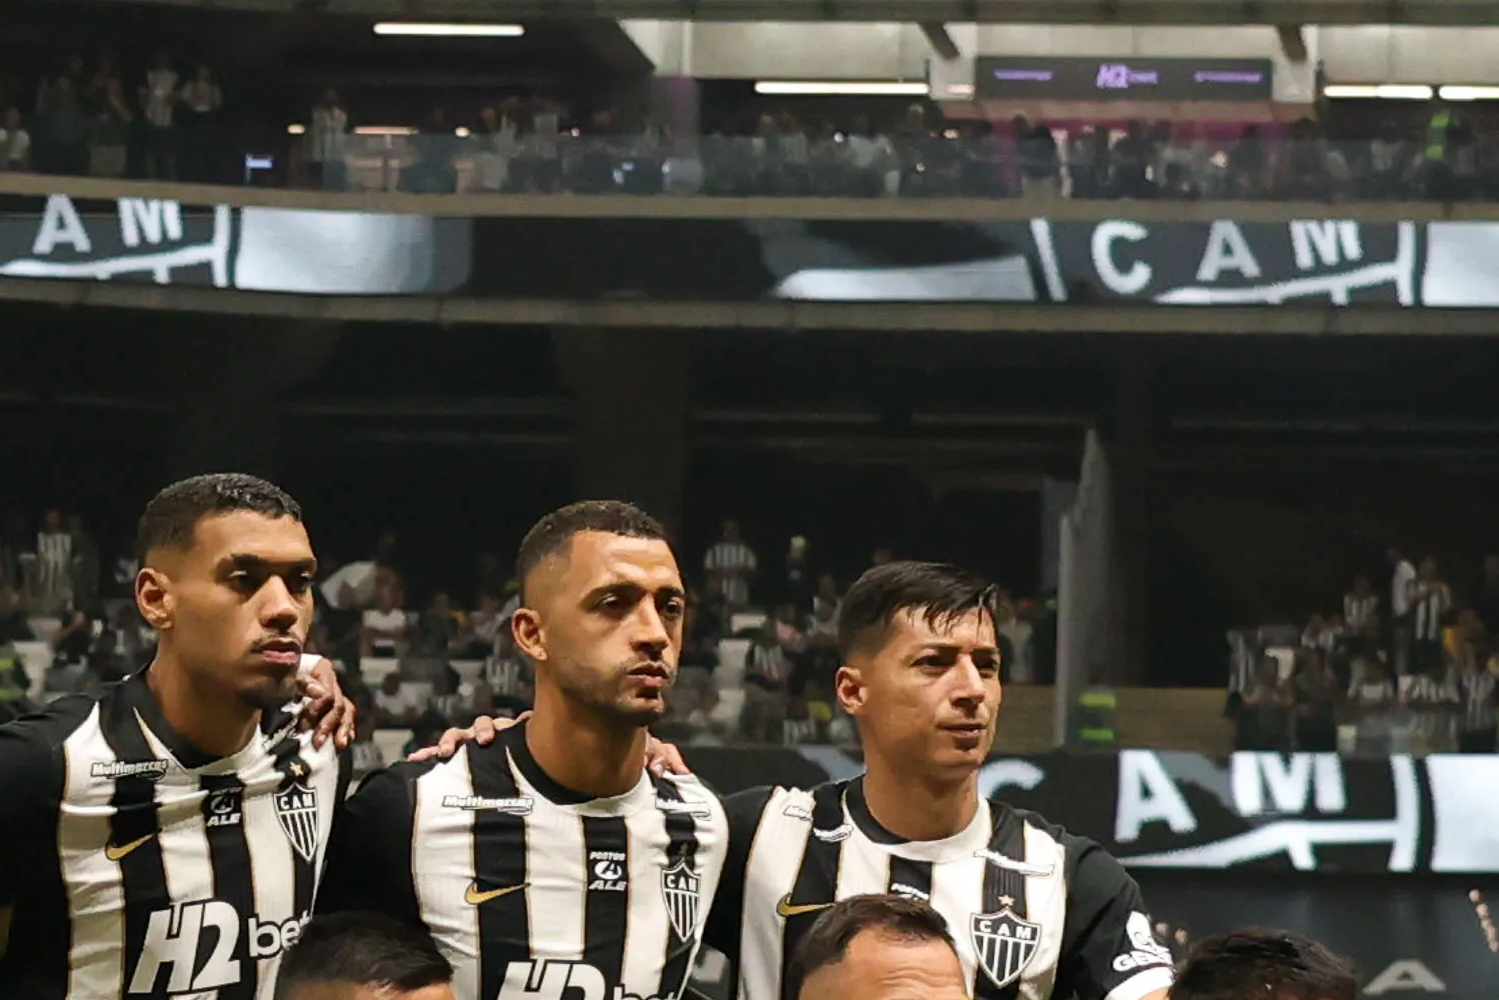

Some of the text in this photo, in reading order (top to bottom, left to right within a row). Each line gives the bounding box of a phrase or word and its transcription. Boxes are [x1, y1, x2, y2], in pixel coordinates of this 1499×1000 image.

[280, 792, 313, 810] CAM
[207, 812, 241, 827] ALE
[588, 879, 627, 892] ALE
[979, 918, 1033, 940] CAM
